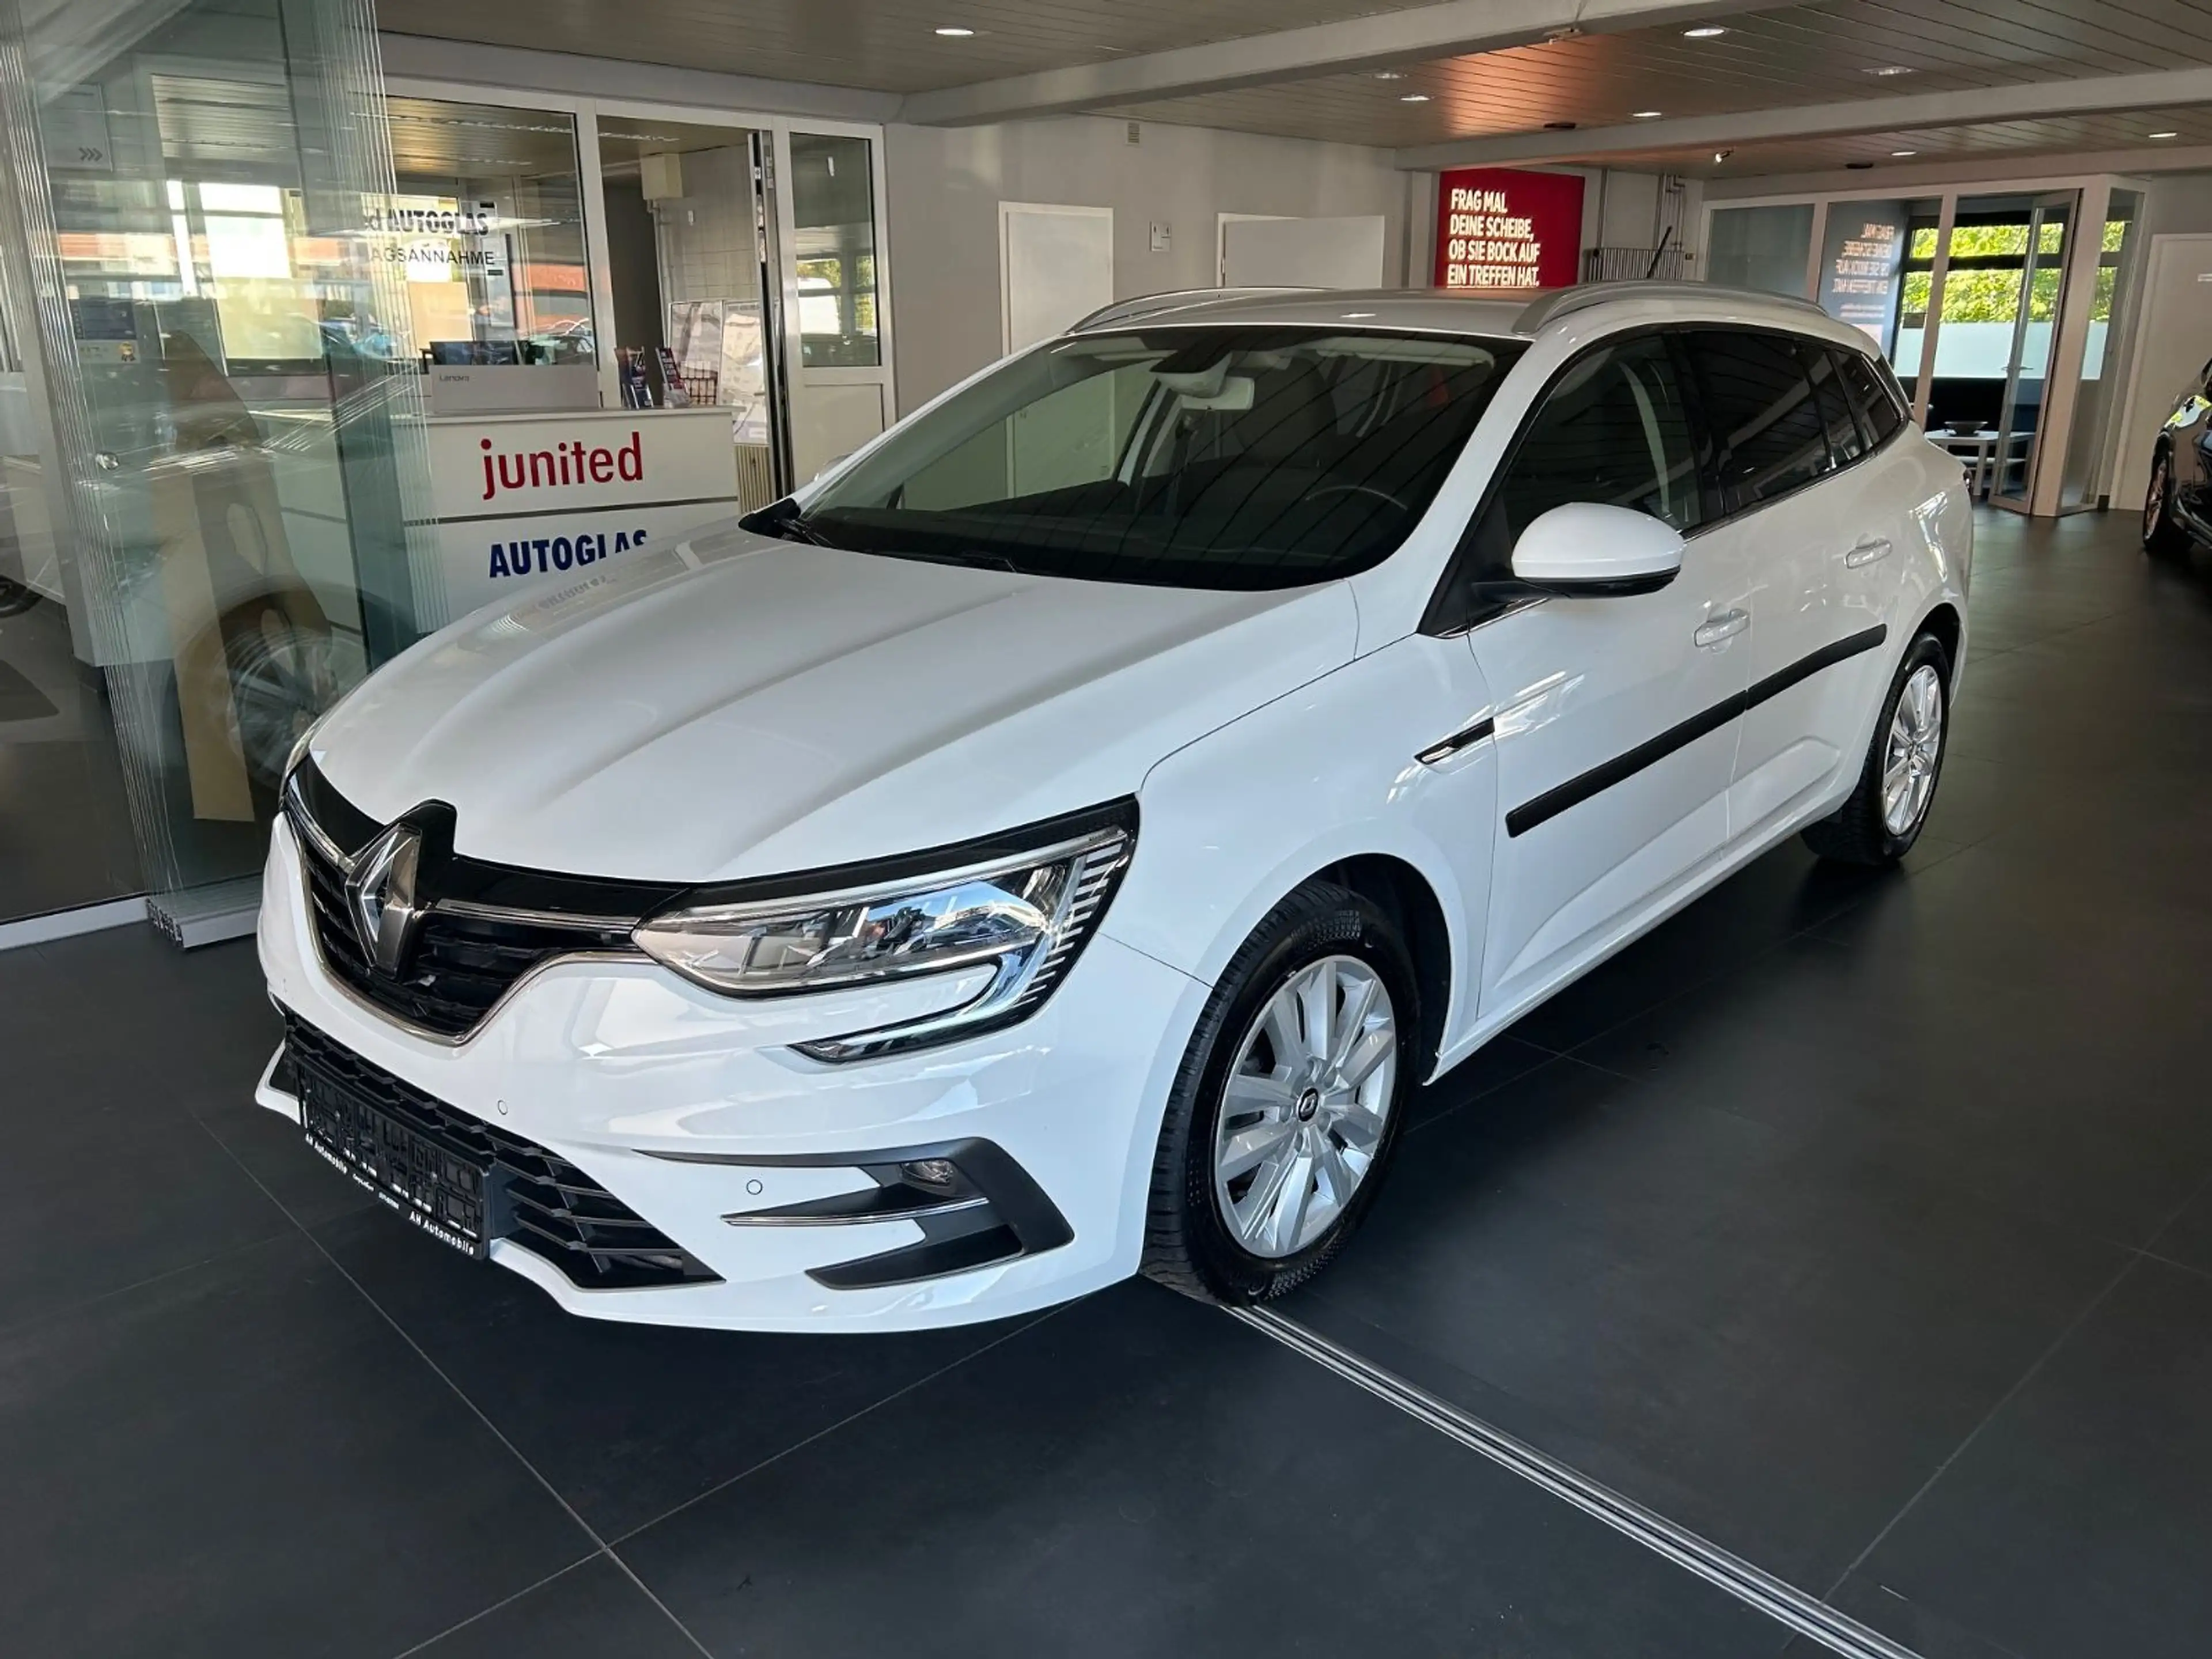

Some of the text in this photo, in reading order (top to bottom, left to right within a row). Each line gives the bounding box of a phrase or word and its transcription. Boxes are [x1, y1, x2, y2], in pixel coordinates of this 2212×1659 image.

[1451, 188, 1508, 213] FRAG MAL
[387, 209, 489, 235] AUTOGLAS
[1450, 214, 1534, 242] DEINE SCHEIBE,
[1449, 239, 1540, 263] OB SIE BOCK AUF
[1447, 264, 1540, 287] EIN TREFFEN HAT.
[480, 431, 642, 500] junited
[409, 1211, 421, 1226] AH
[423, 1219, 474, 1255] Automobile
